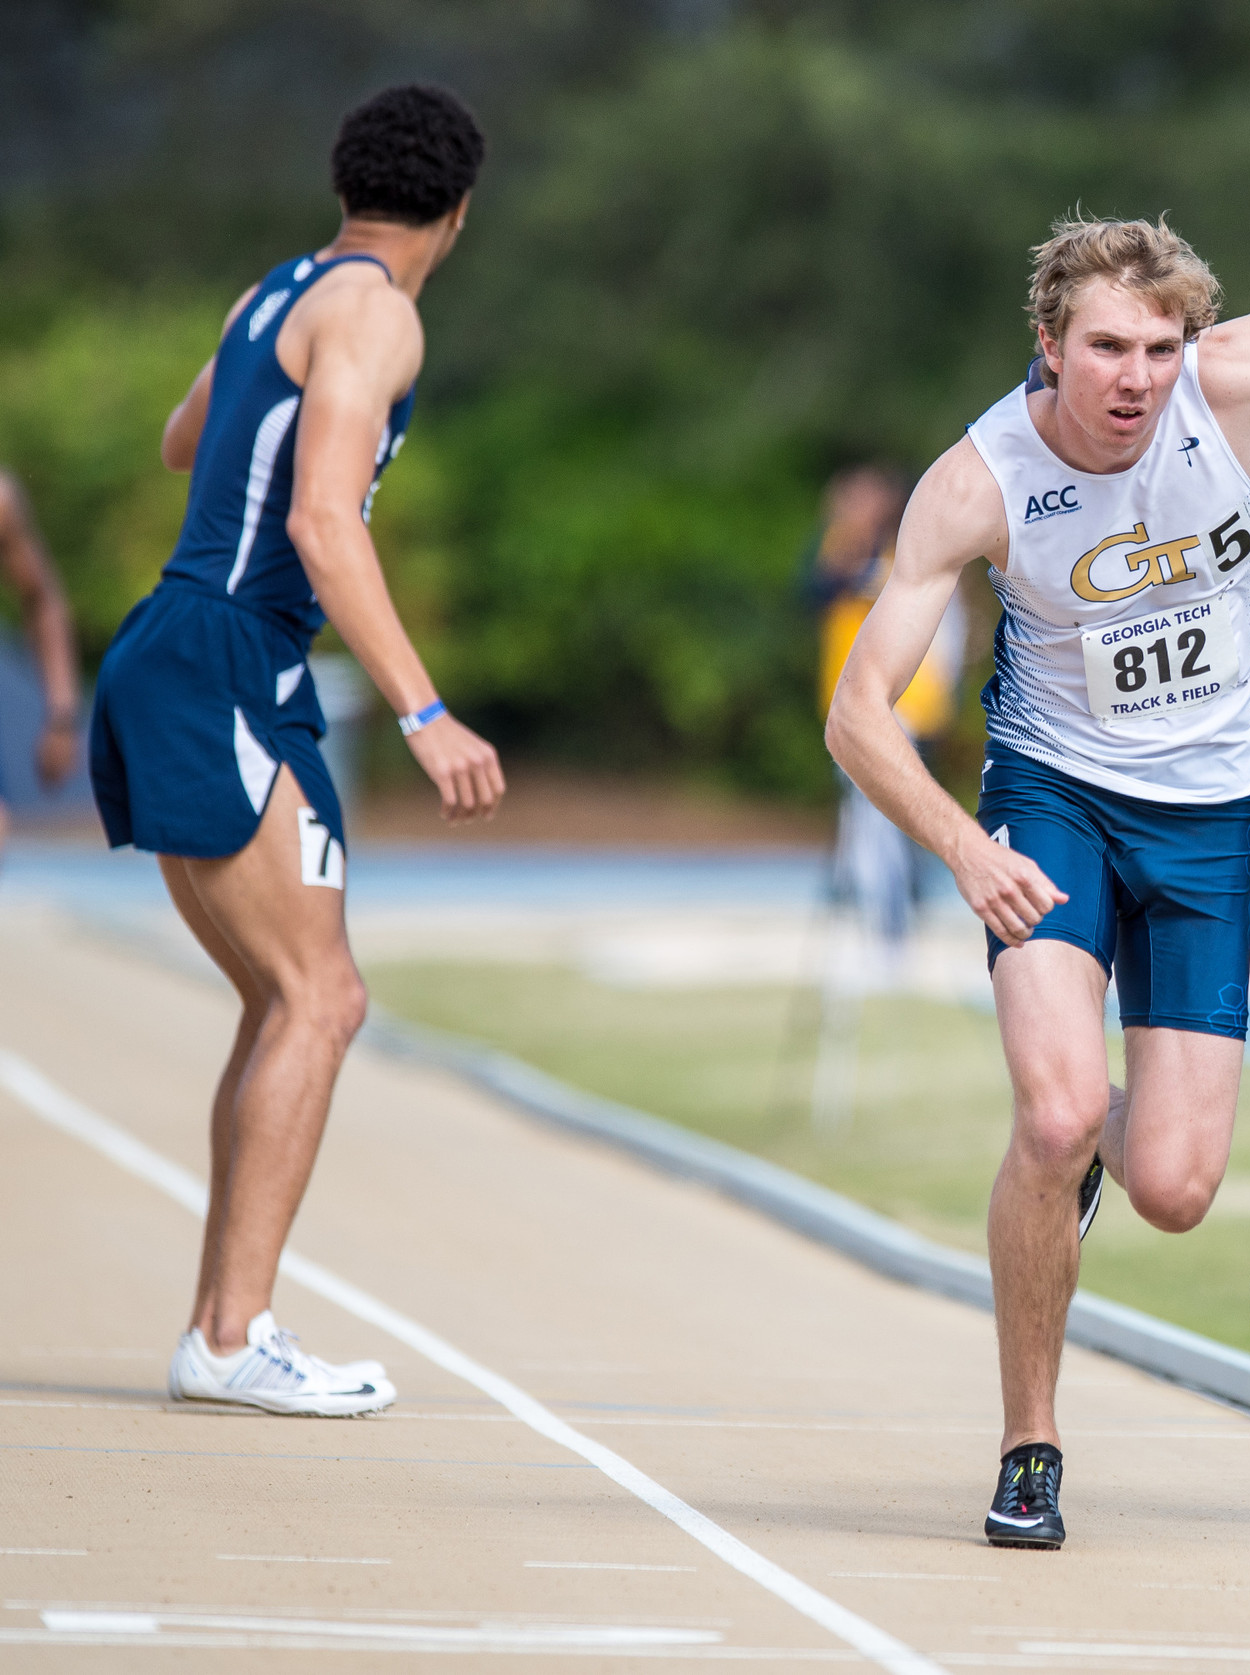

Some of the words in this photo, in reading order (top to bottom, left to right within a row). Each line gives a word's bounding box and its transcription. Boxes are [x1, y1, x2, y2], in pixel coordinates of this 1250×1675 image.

[1024, 484, 1079, 520] ACC
[1101, 617, 1172, 646] GEORGIA
[1174, 603, 1212, 625] TECH
[1112, 627, 1211, 693] 812
[1110, 695, 1161, 715] TRACK
[1166, 692, 1177, 705] &
[1182, 682, 1221, 702] FIELD
[307, 818, 335, 877] 7
